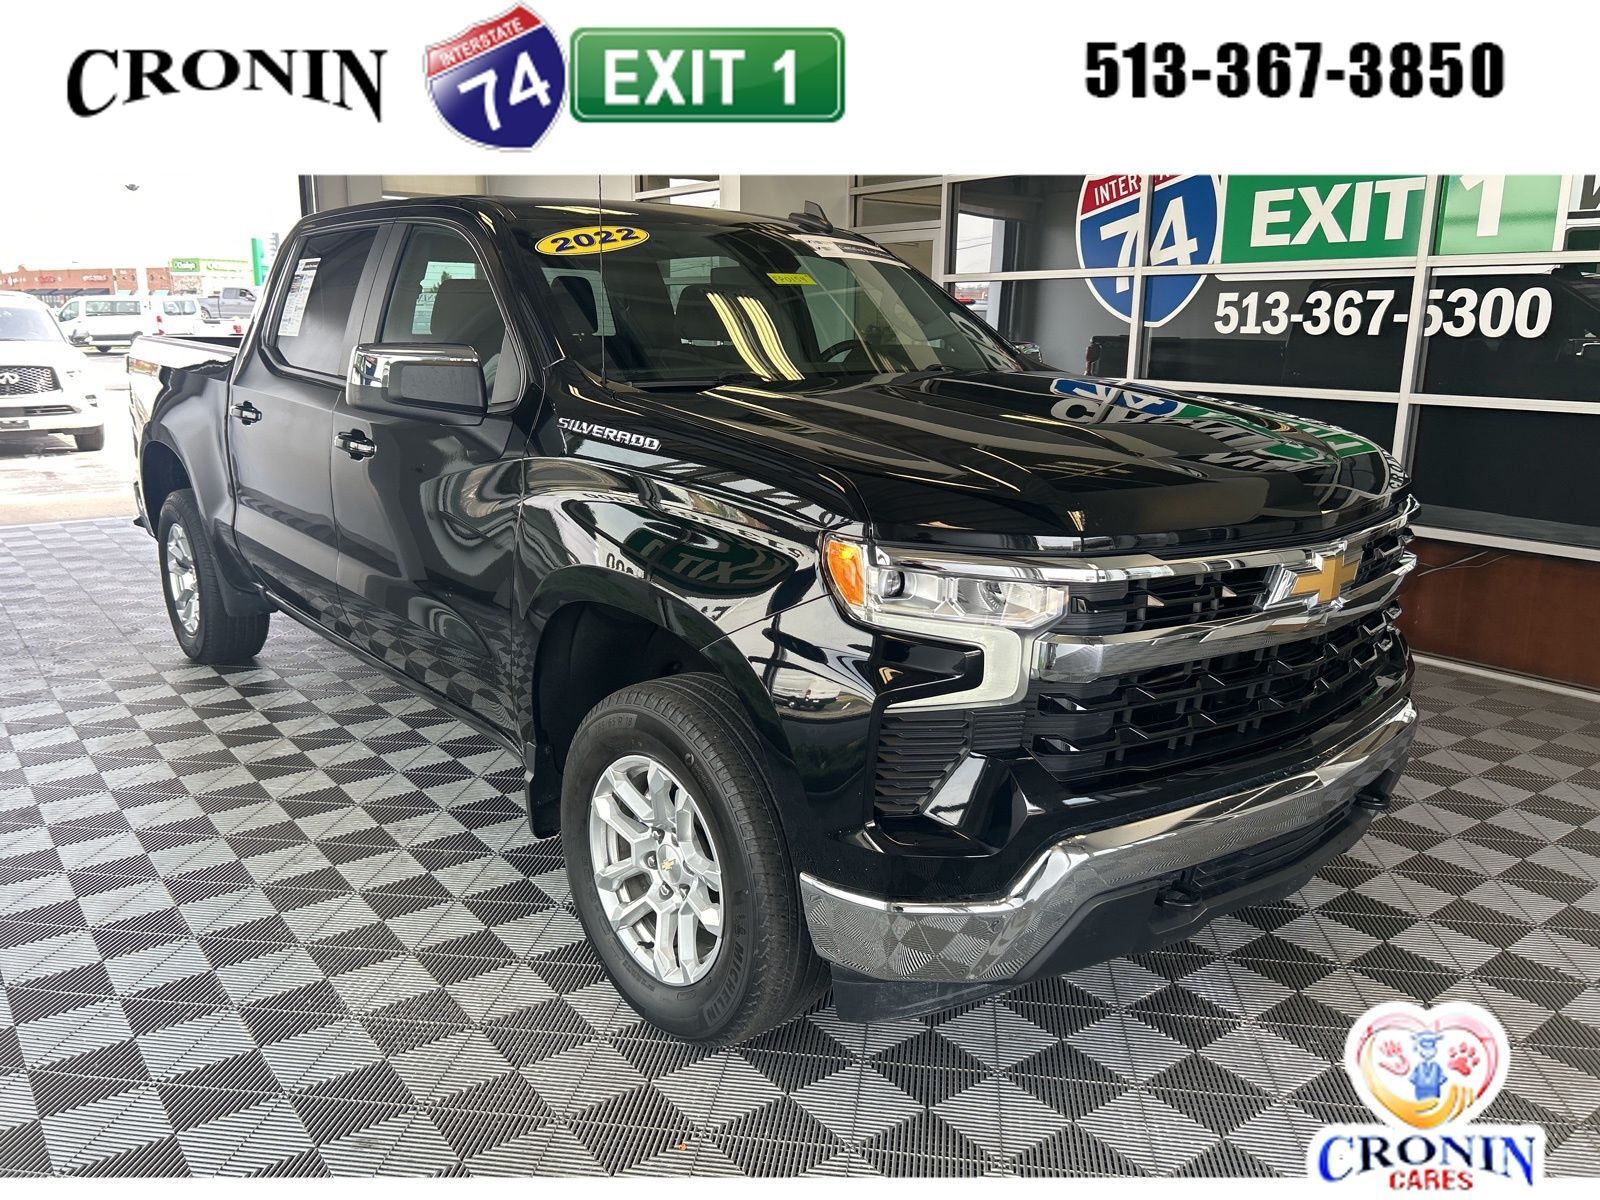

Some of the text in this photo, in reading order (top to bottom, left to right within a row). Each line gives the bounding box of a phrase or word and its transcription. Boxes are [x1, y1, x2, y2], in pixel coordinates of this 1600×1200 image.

[551, 228, 641, 252] 2022
[1250, 177, 1426, 247] EXIT
[1460, 175, 1506, 237] 1
[1100, 195, 1198, 294] 74
[1214, 287, 1552, 338] 513-367-5300
[557, 418, 661, 451] SILVERADO
[705, 940, 745, 1023] MICHELIN
